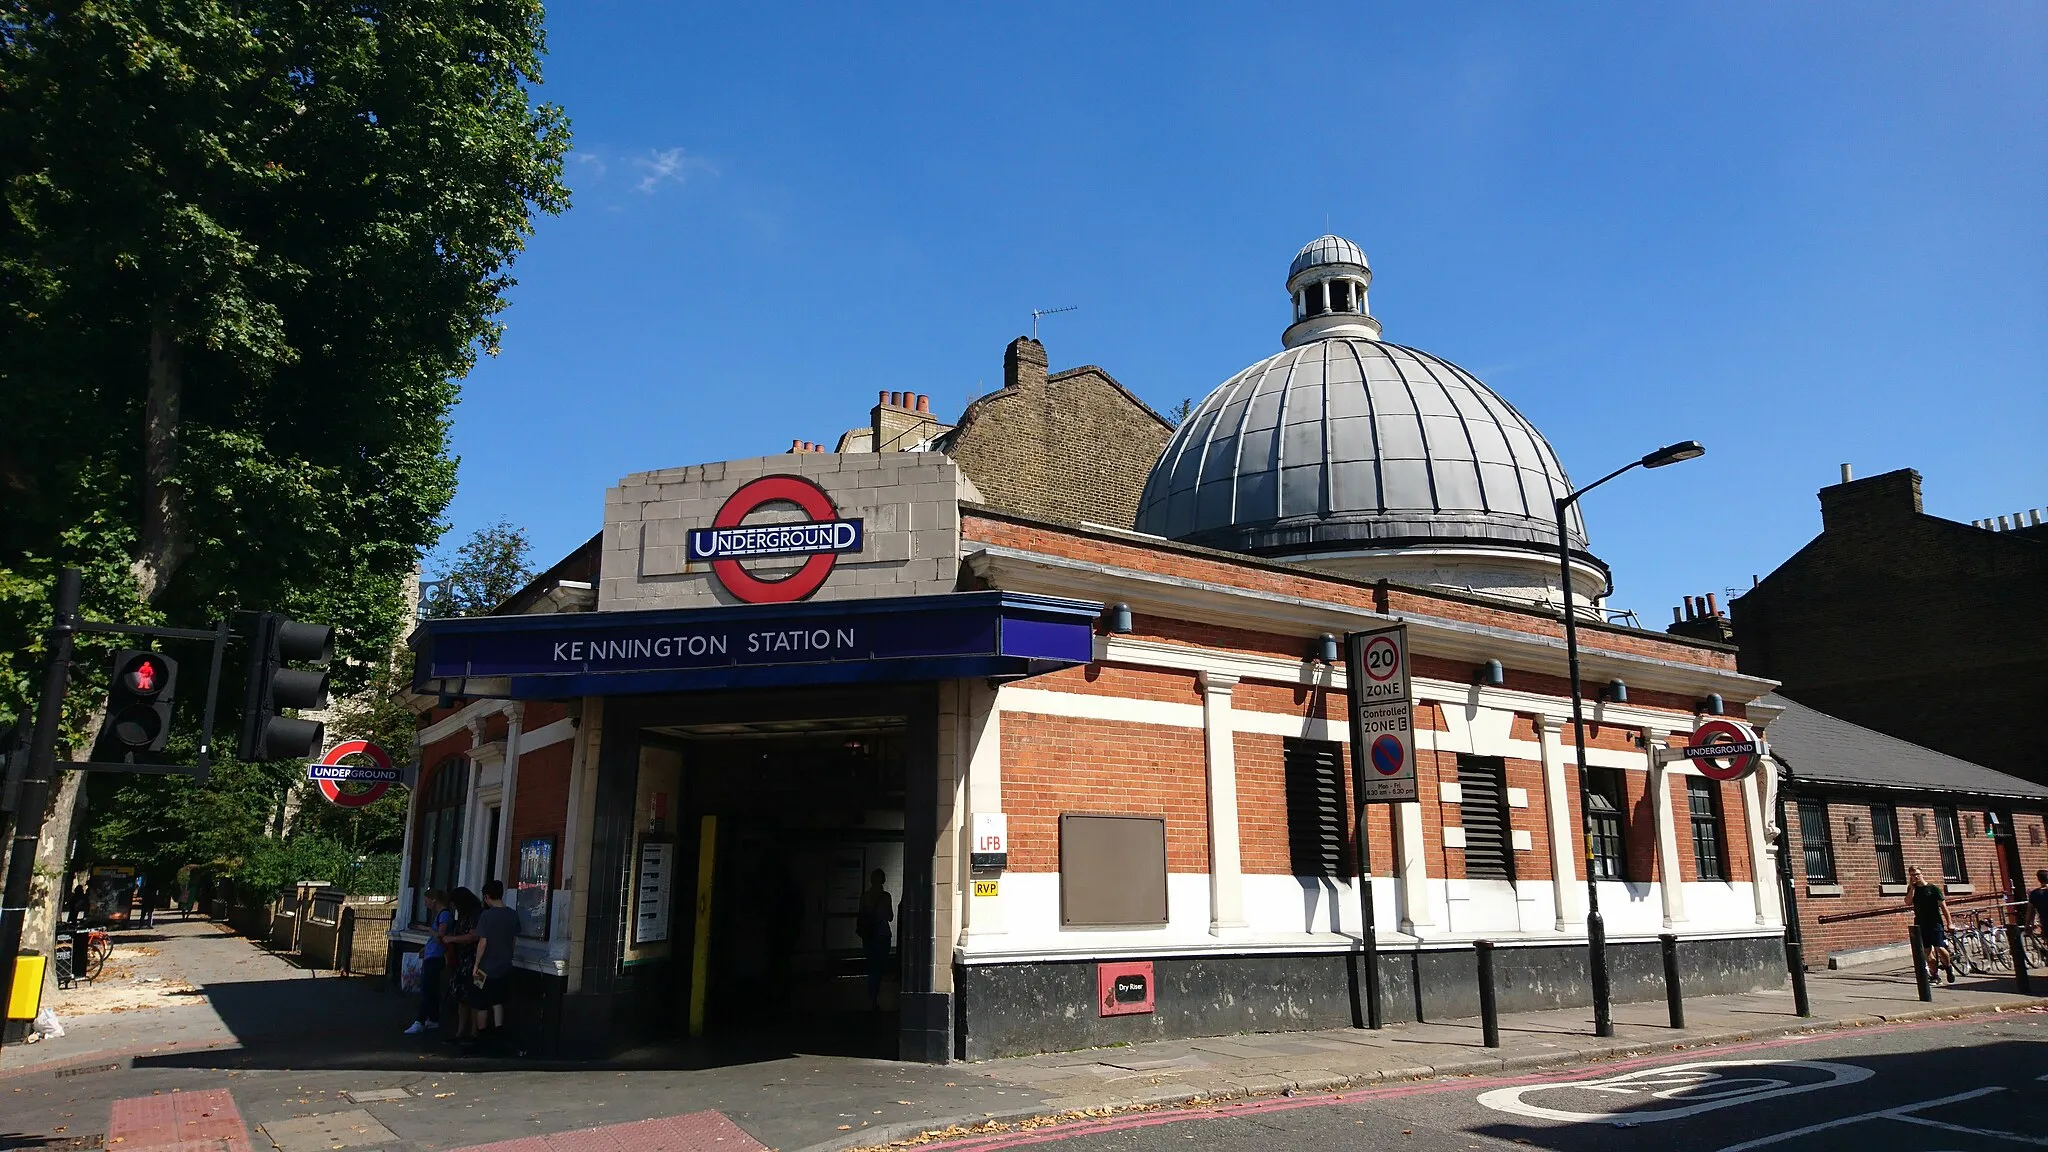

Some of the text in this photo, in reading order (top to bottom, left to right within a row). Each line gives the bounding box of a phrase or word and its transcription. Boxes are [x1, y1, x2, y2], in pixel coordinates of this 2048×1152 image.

[695, 523, 856, 557] UNDERGROUND
[553, 628, 854, 661] KENNINGTON STATION
[1369, 648, 1394, 669] 20
[1367, 683, 1400, 697] ZONE
[1363, 706, 1407, 718] Controlled
[1364, 717, 1407, 733] ZONE E
[1686, 744, 1753, 756] UNDERGROUND
[314, 768, 396, 779] UNDERGROUND
[980, 836, 1001, 851] LFB
[977, 883, 997, 894] RVP
[1118, 984, 1129, 992] Dry
